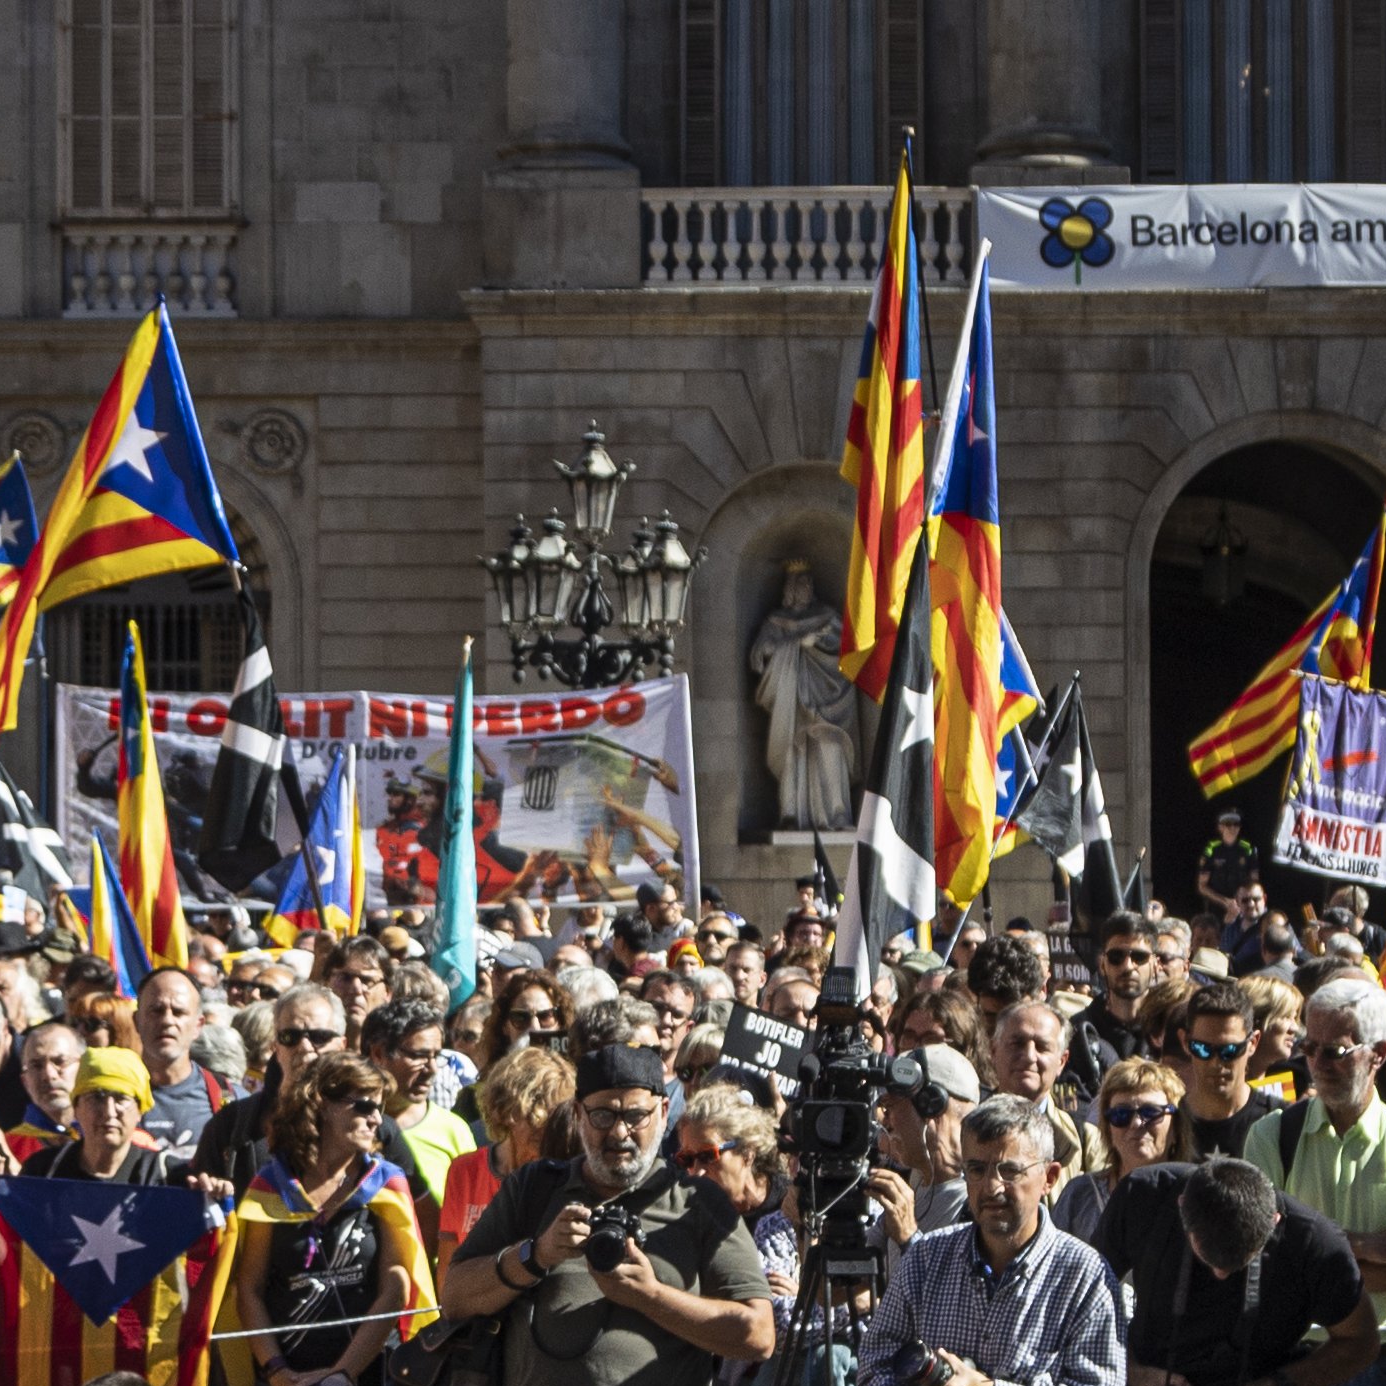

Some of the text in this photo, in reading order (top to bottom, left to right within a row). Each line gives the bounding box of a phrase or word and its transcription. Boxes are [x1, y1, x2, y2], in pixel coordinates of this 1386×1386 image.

[1130, 212, 1319, 247] Barcelona
[369, 698, 428, 738] NI
[744, 1012, 805, 1050] BOTIFLER
[755, 1040, 782, 1069] JO
